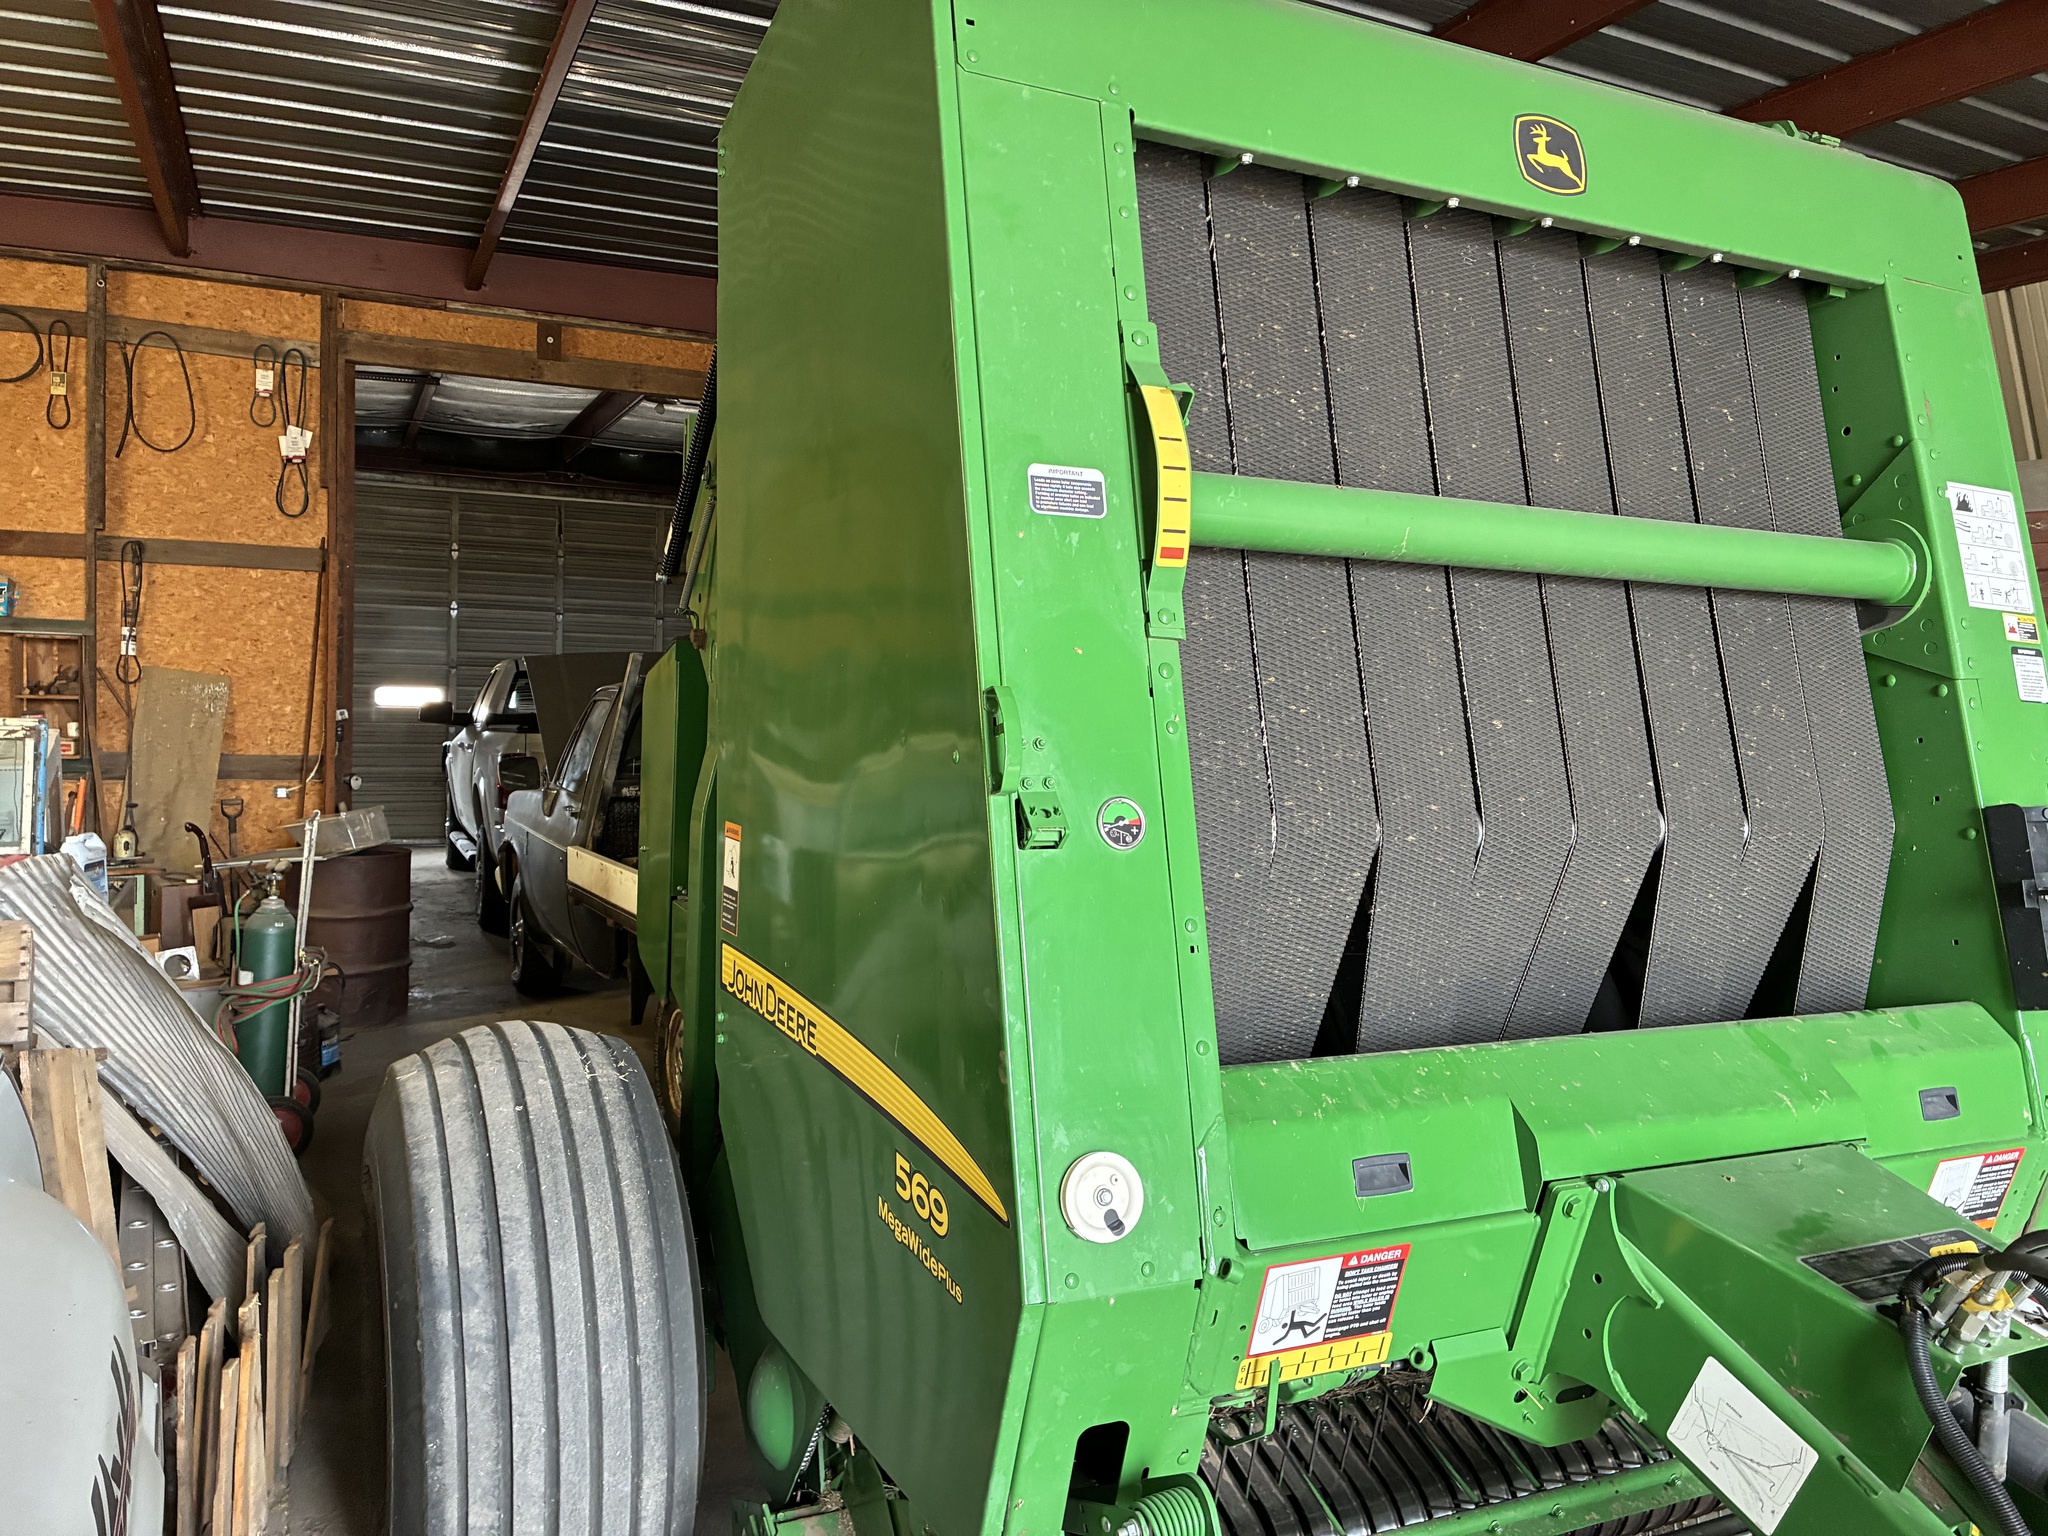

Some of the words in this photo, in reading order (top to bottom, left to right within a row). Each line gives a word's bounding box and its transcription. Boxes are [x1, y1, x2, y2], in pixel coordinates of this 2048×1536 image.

[1048, 469, 1084, 477] IMPORTANT
[728, 960, 764, 1008] JOHN
[766, 982, 817, 1052] DEERE
[1993, 1152, 2020, 1161] DANGER
[895, 1150, 949, 1239] 569
[878, 1195, 963, 1305] MegaWidePlus
[1360, 1249, 1402, 1263] DANGER
